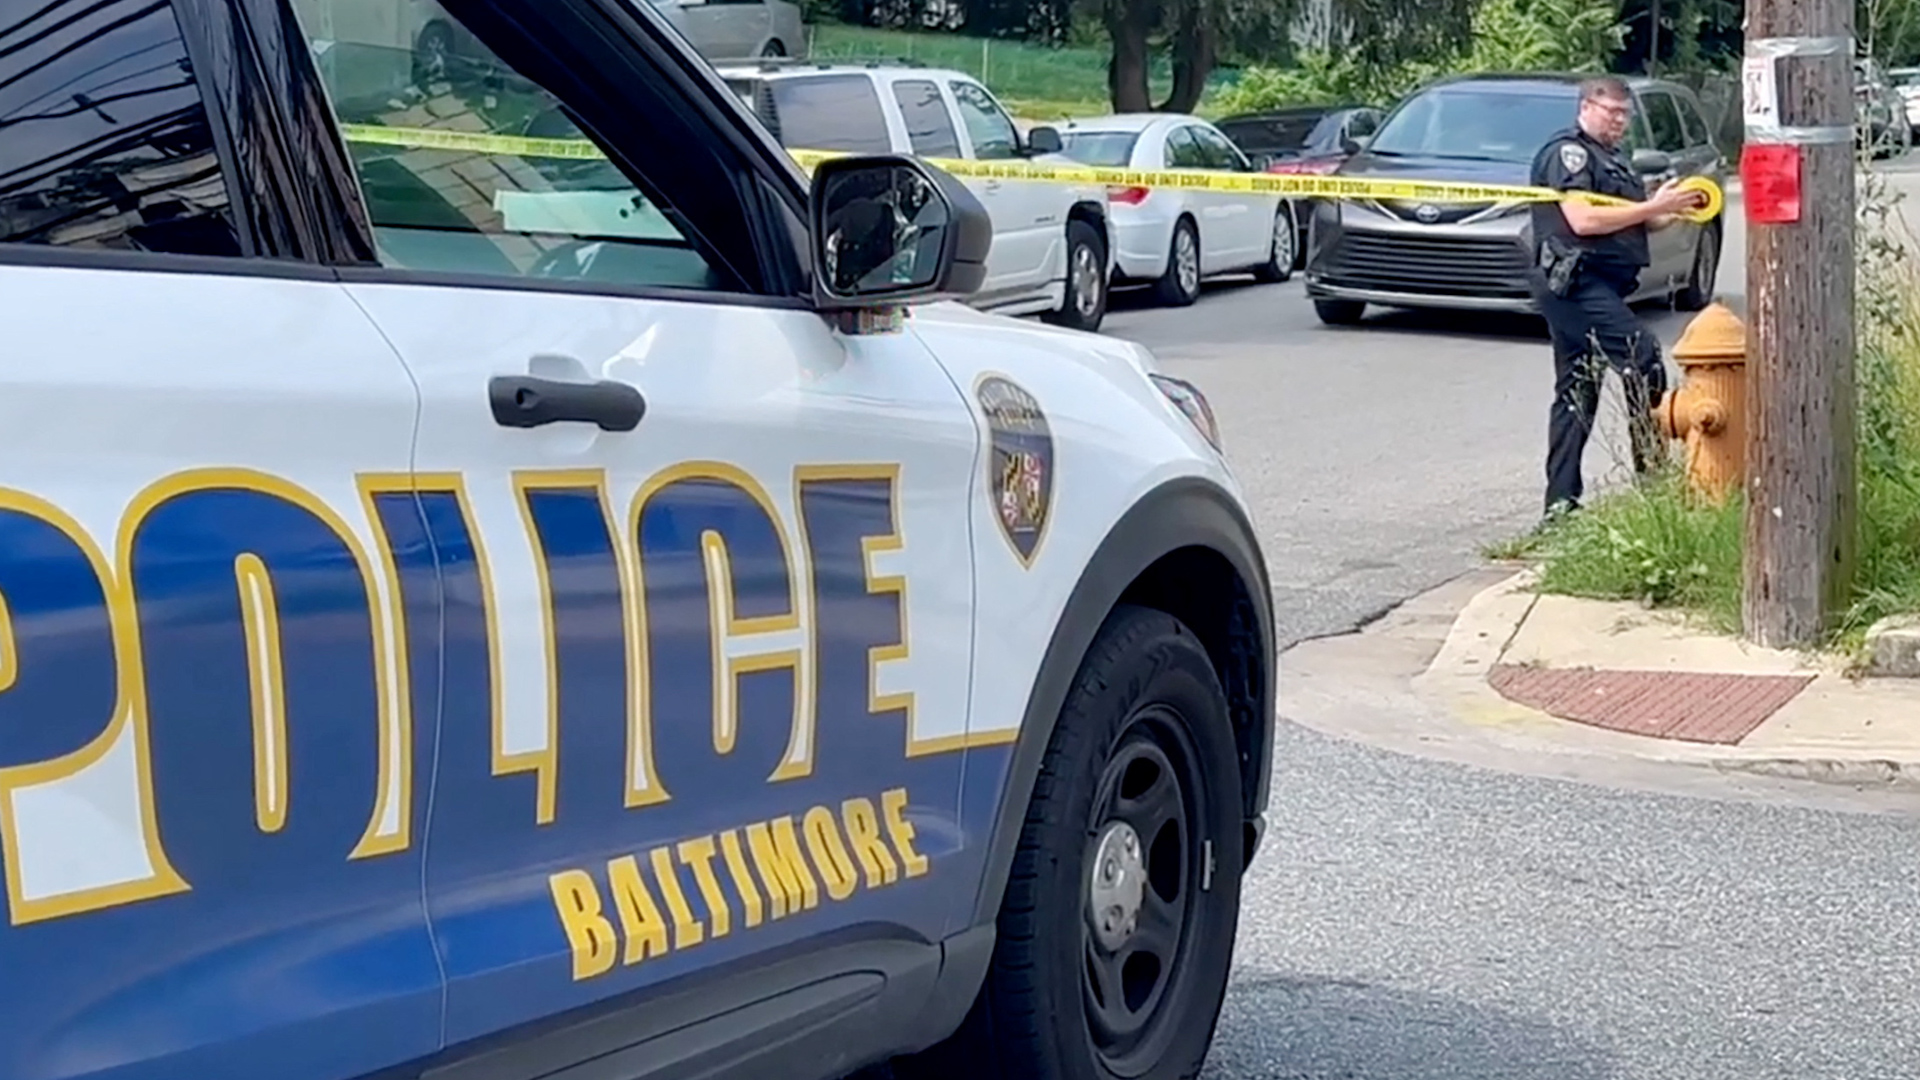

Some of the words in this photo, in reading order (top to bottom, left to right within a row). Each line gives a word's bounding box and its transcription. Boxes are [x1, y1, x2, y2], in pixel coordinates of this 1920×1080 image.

[1144, 173, 1157, 184] DO
[1181, 174, 1211, 187] POLICE
[1282, 179, 1299, 191] NOT
[1302, 179, 1315, 192] DO
[1340, 181, 1371, 194] POLICE
[549, 787, 929, 981] BALTIMORE
